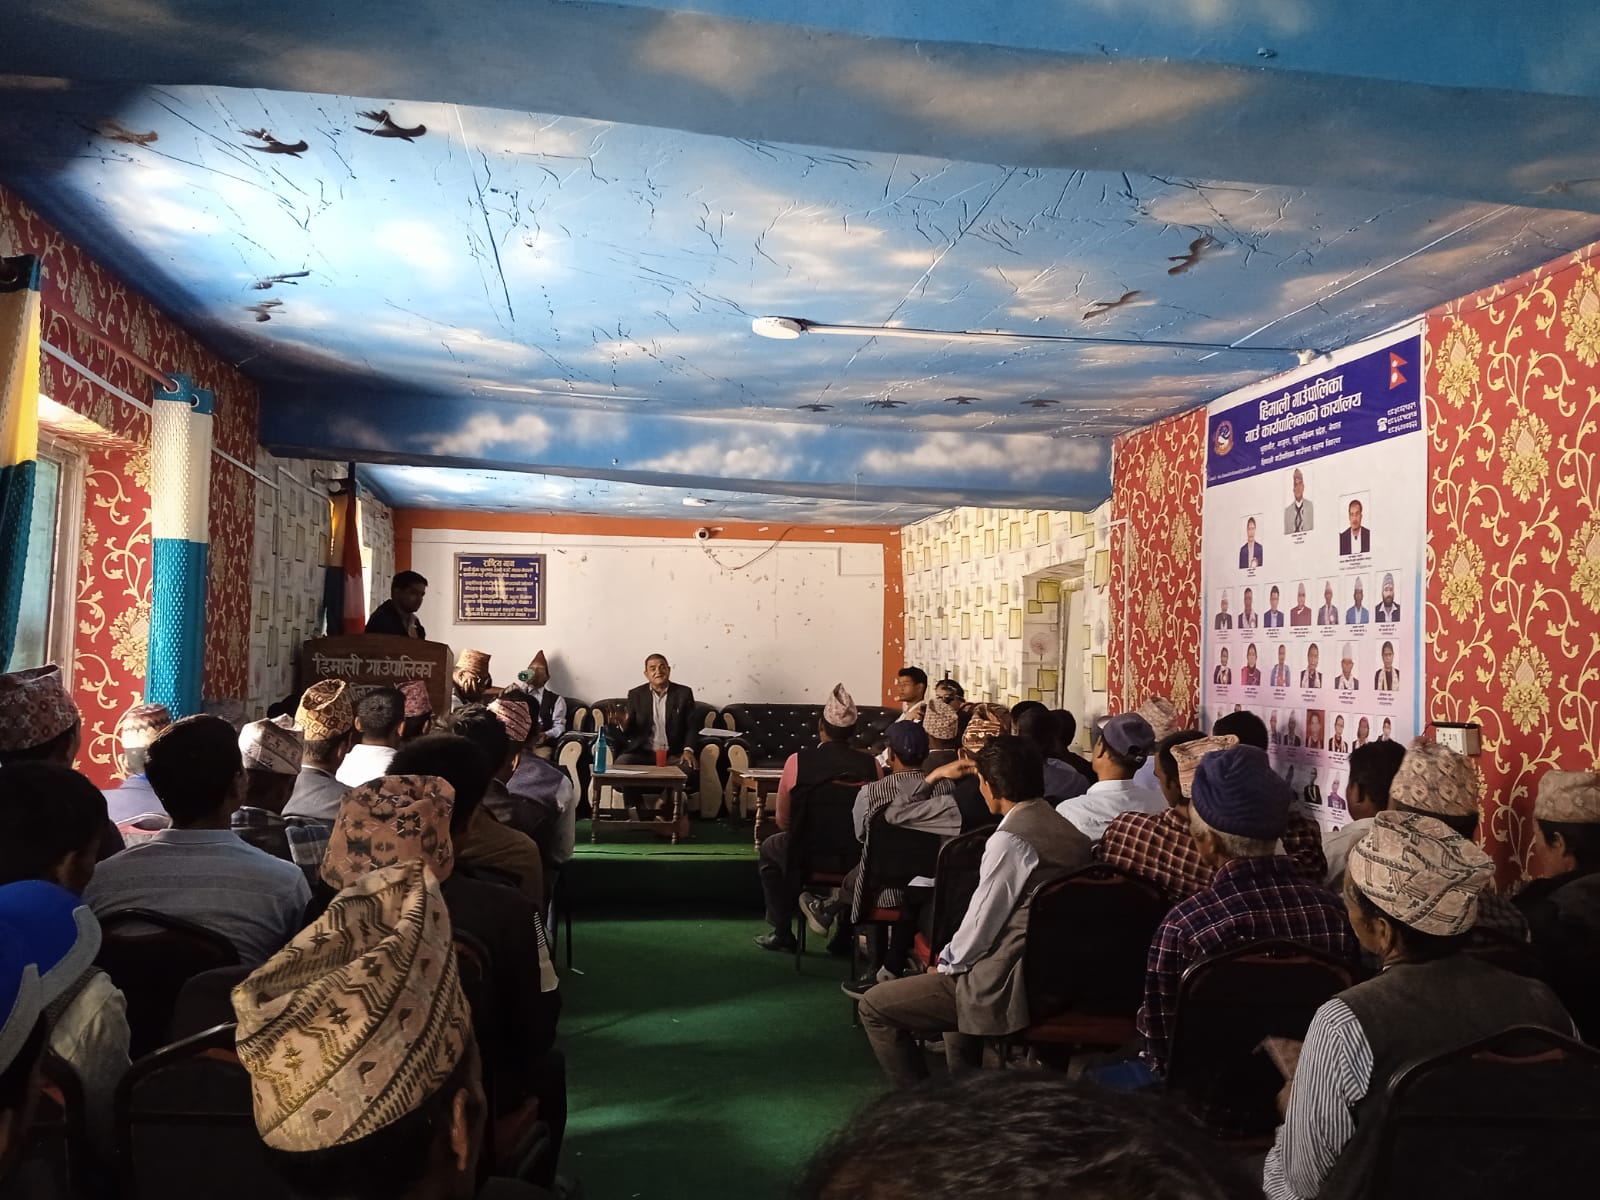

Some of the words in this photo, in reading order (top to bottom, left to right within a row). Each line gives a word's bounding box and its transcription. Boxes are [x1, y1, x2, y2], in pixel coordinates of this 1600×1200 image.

[1259, 392, 1291, 421] हिमाली
[1261, 404, 1319, 438] कार्यपालिकाको
[1321, 392, 1362, 418] कार्यालय
[312, 652, 363, 678] हिमाली
